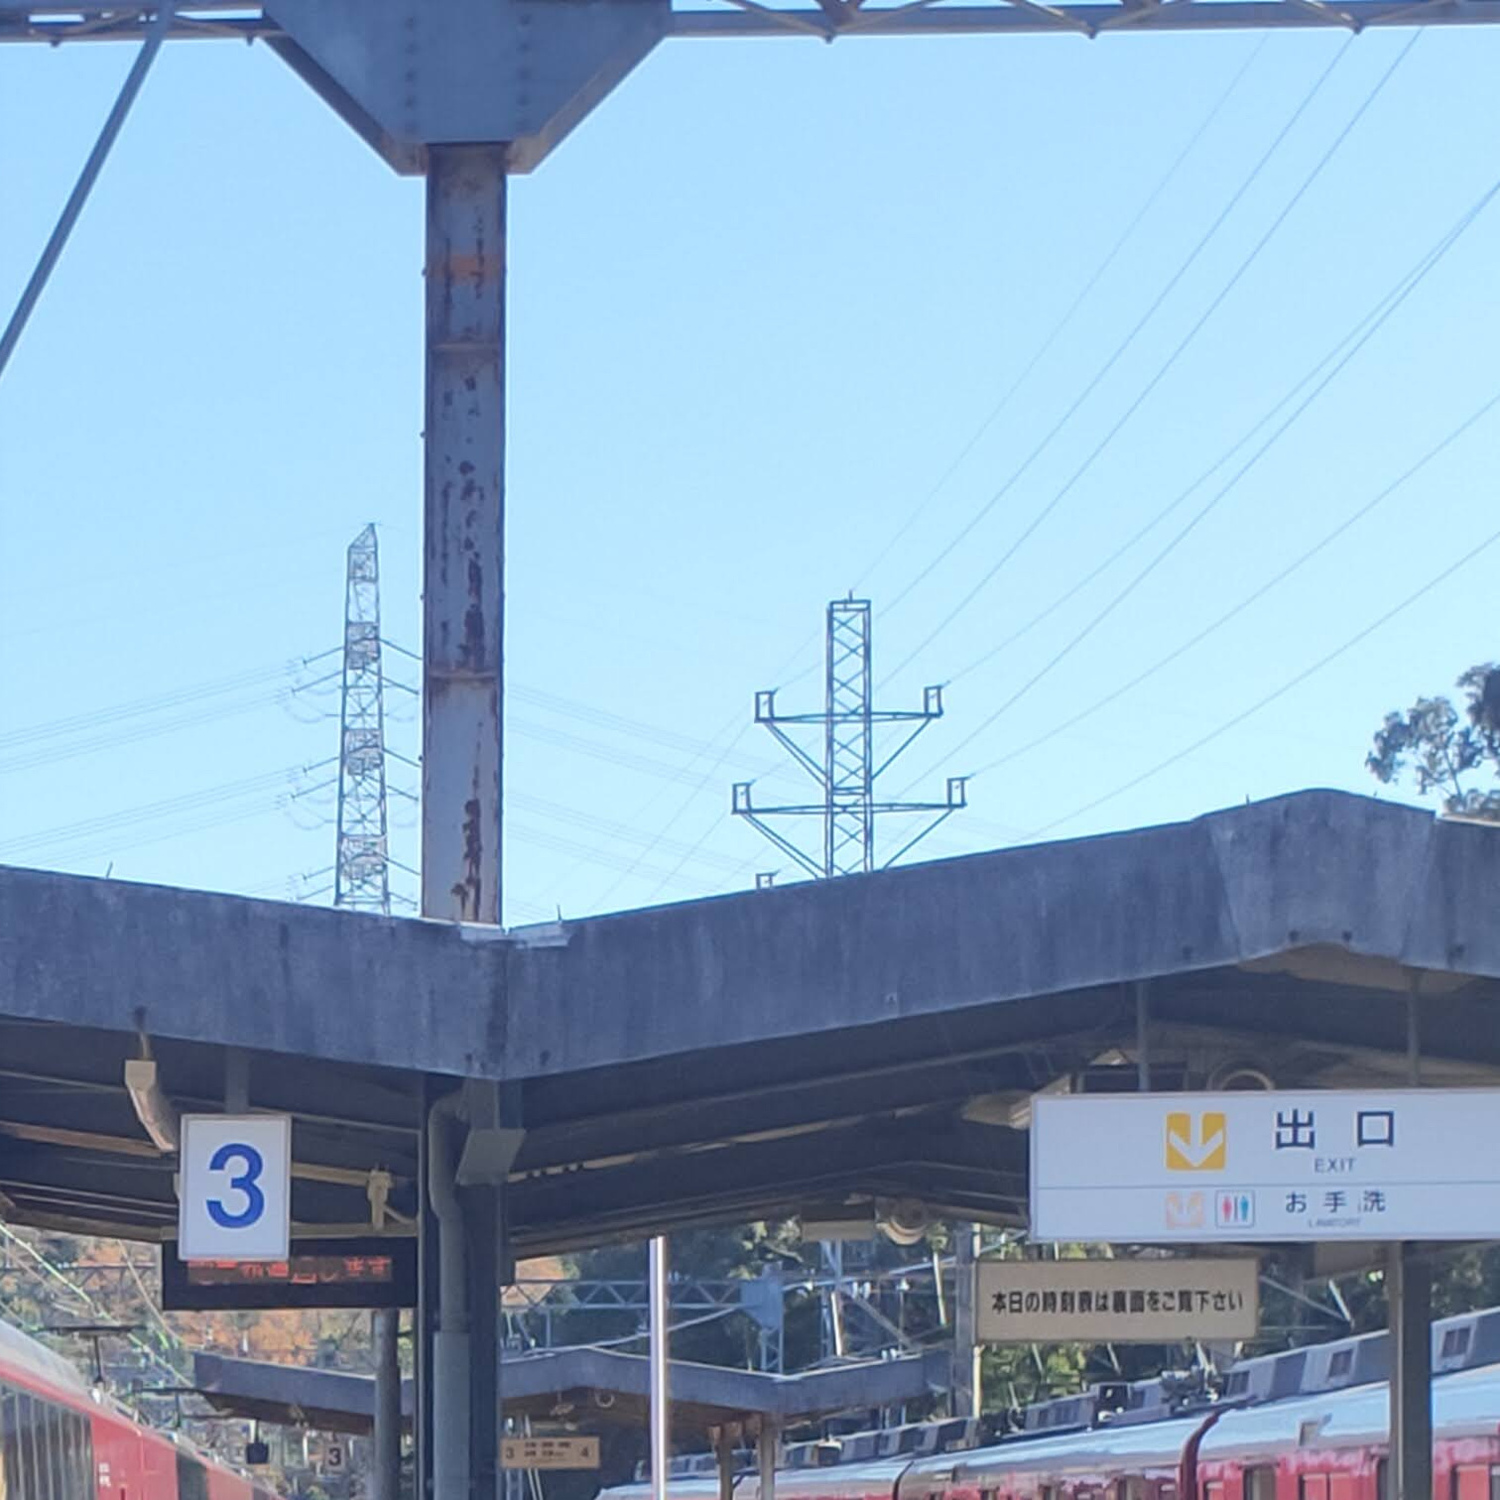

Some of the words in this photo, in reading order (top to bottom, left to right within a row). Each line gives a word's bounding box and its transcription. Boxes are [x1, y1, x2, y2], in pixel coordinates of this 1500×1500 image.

[1275, 1109, 1395, 1149] 出口
[1314, 1157, 1357, 1173] EXIT
[206, 1143, 265, 1228] 3
[1285, 1190, 1386, 1213] お手洗
[329, 1447, 341, 1467] 3
